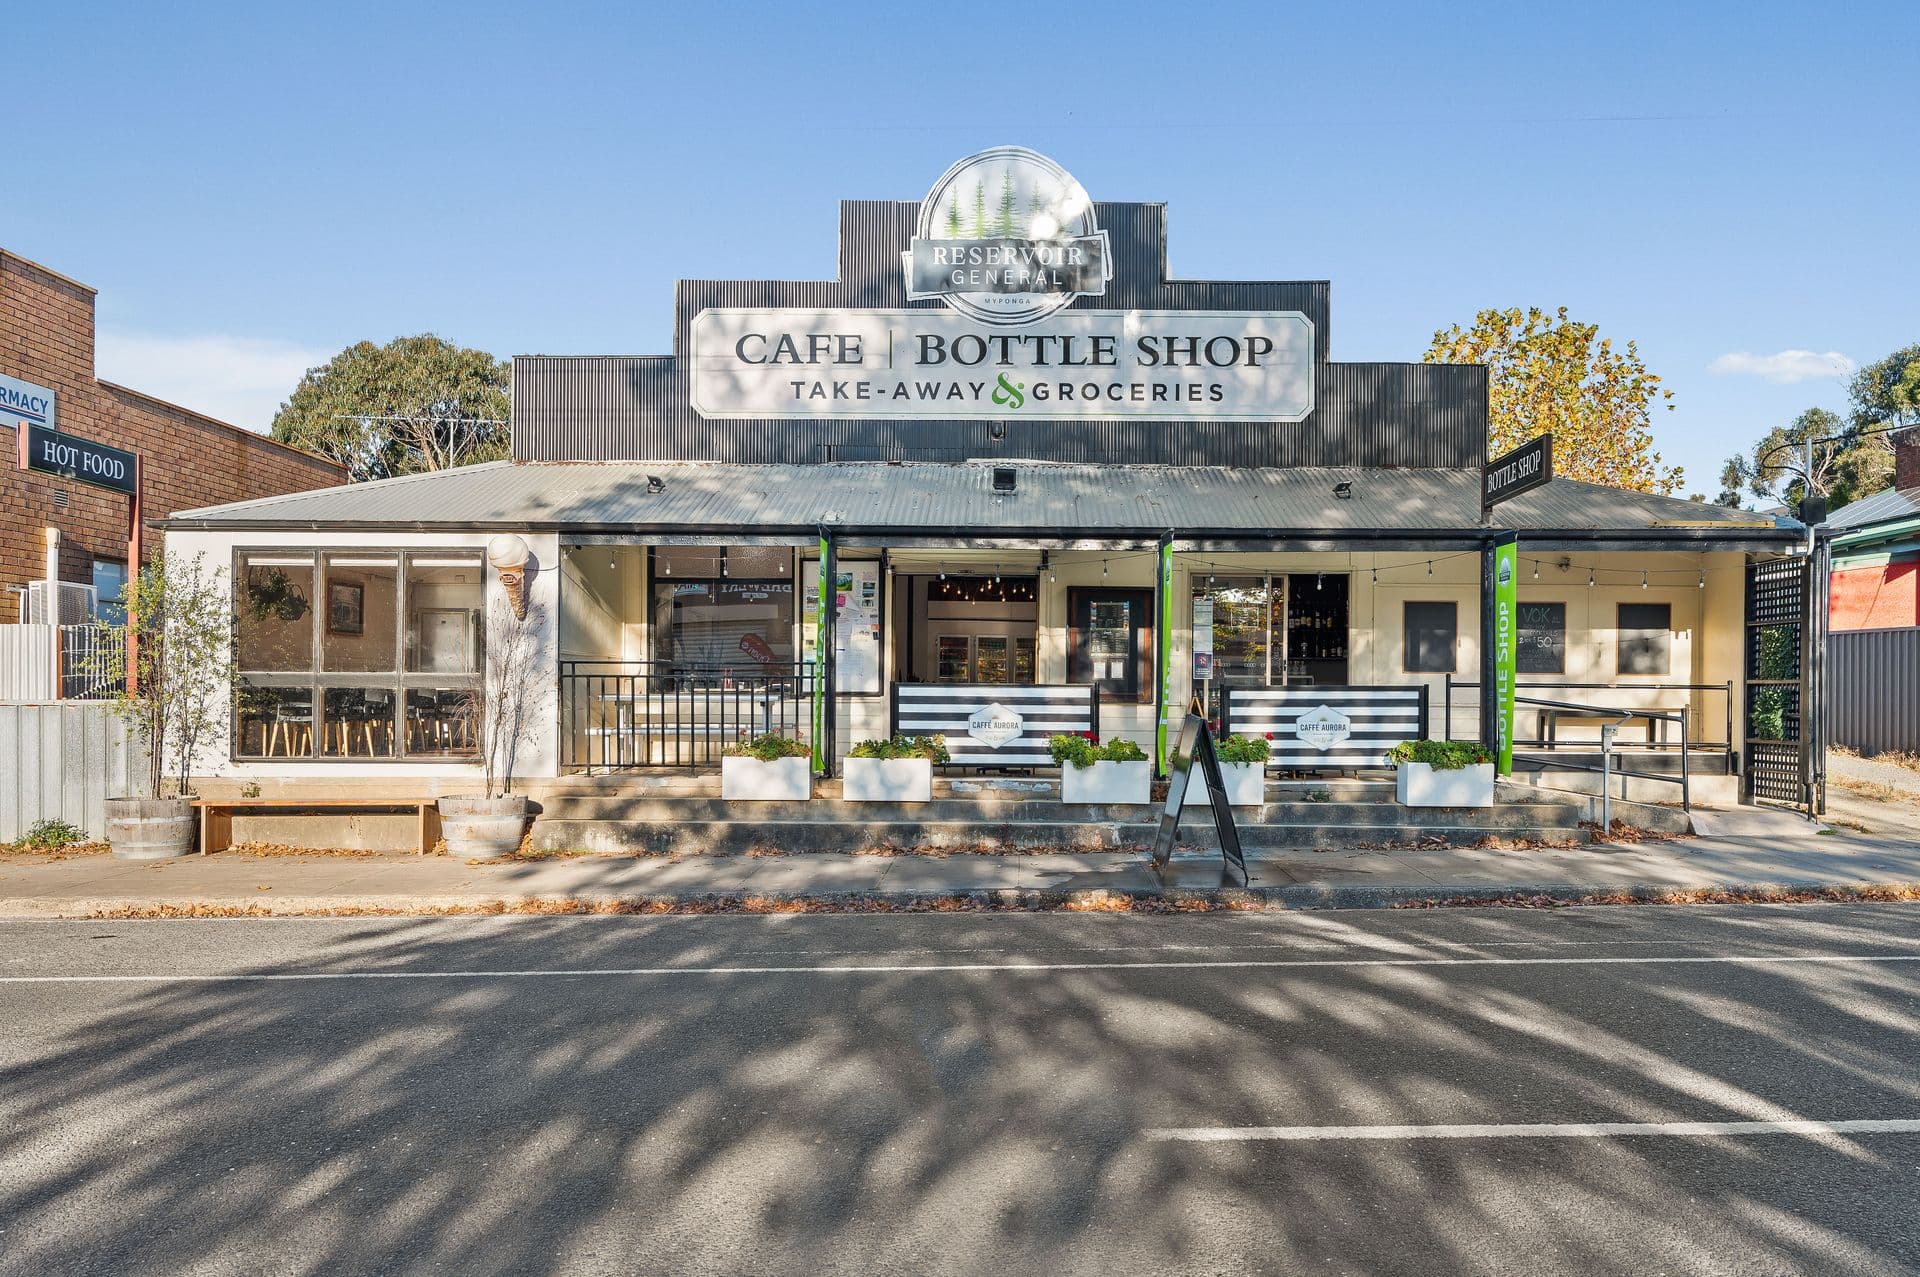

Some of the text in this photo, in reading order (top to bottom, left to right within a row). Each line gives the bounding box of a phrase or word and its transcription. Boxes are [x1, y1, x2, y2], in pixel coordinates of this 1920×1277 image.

[933, 246, 1083, 266] RESERVOIR
[951, 269, 1063, 285] GENERAL
[735, 333, 1274, 367] CAFE BOTTLE SHOP
[790, 371, 1224, 409] TAKE-AWAY & GROCERIES
[43, 440, 125, 479] HOT FOOD
[1487, 449, 1541, 493] BOTTLE SHOP
[1498, 601, 1509, 751] BOTTLE SHOP
[993, 720, 1019, 729] AURORA
[1321, 723, 1347, 731] AURORA
